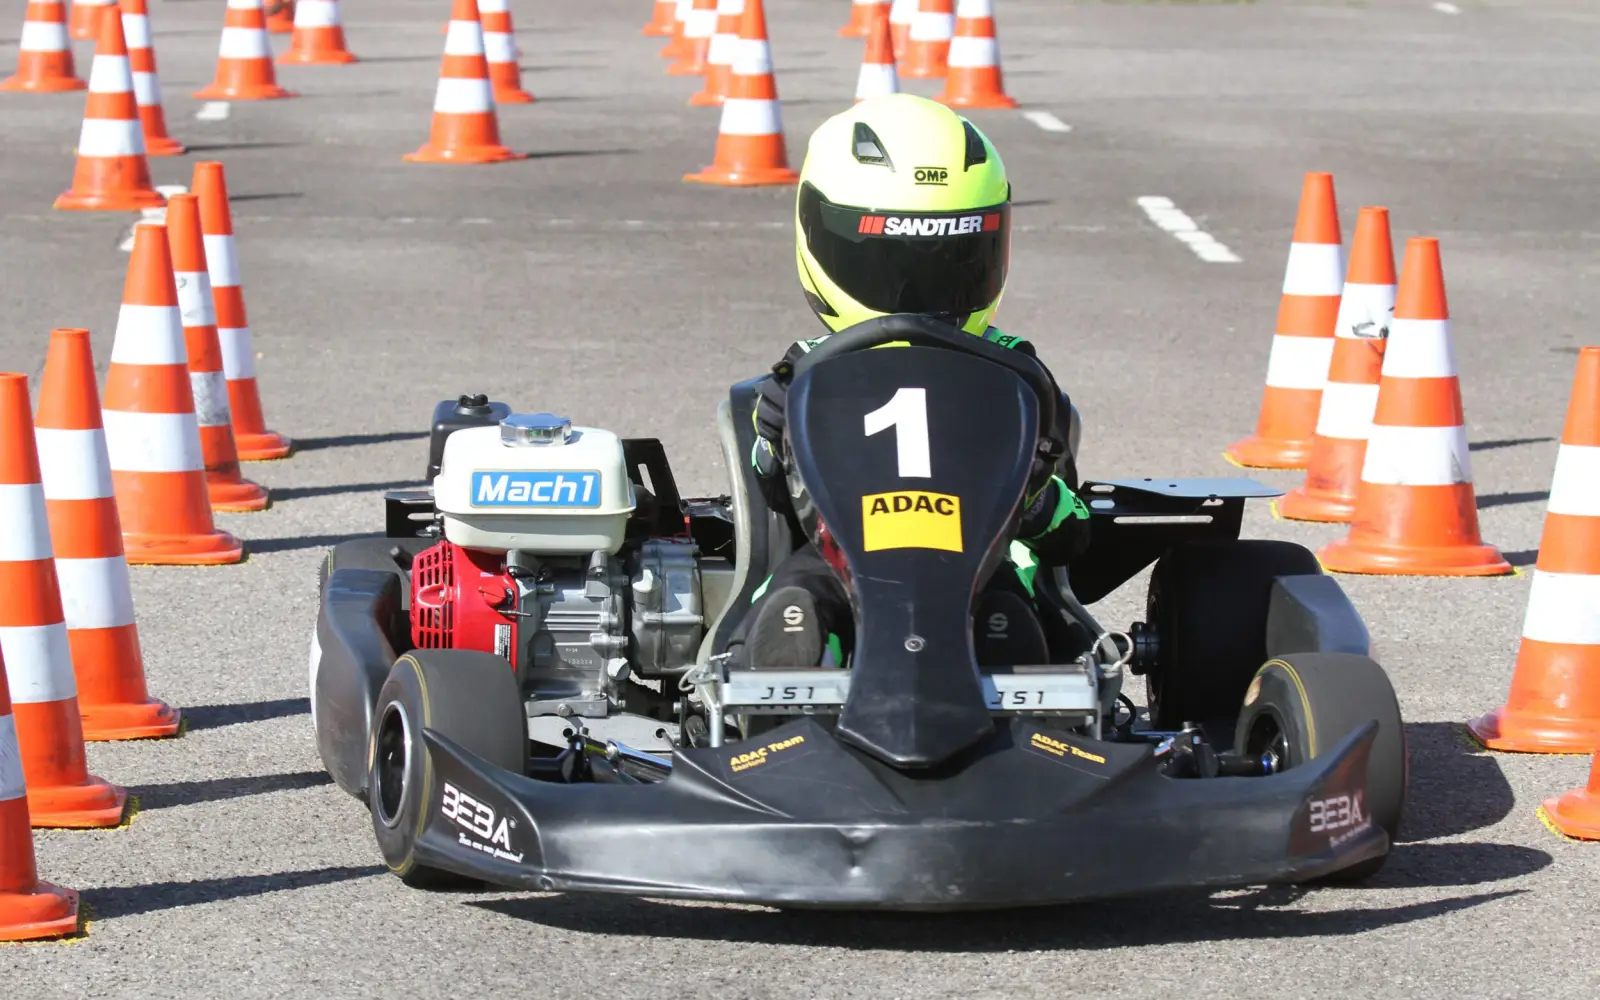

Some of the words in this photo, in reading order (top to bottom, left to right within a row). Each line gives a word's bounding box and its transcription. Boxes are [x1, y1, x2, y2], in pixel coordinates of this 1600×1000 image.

[914, 169, 948, 183] OMP
[884, 215, 983, 236] SANDTLER
[864, 388, 932, 478] 1
[870, 495, 954, 516] ADAC
[730, 747, 768, 766] ADAC
[767, 735, 804, 752] Team
[1031, 732, 1070, 752] ADAC
[1070, 746, 1106, 764] Team
[441, 782, 511, 852] BEBA
[1309, 794, 1363, 833] BEBA
